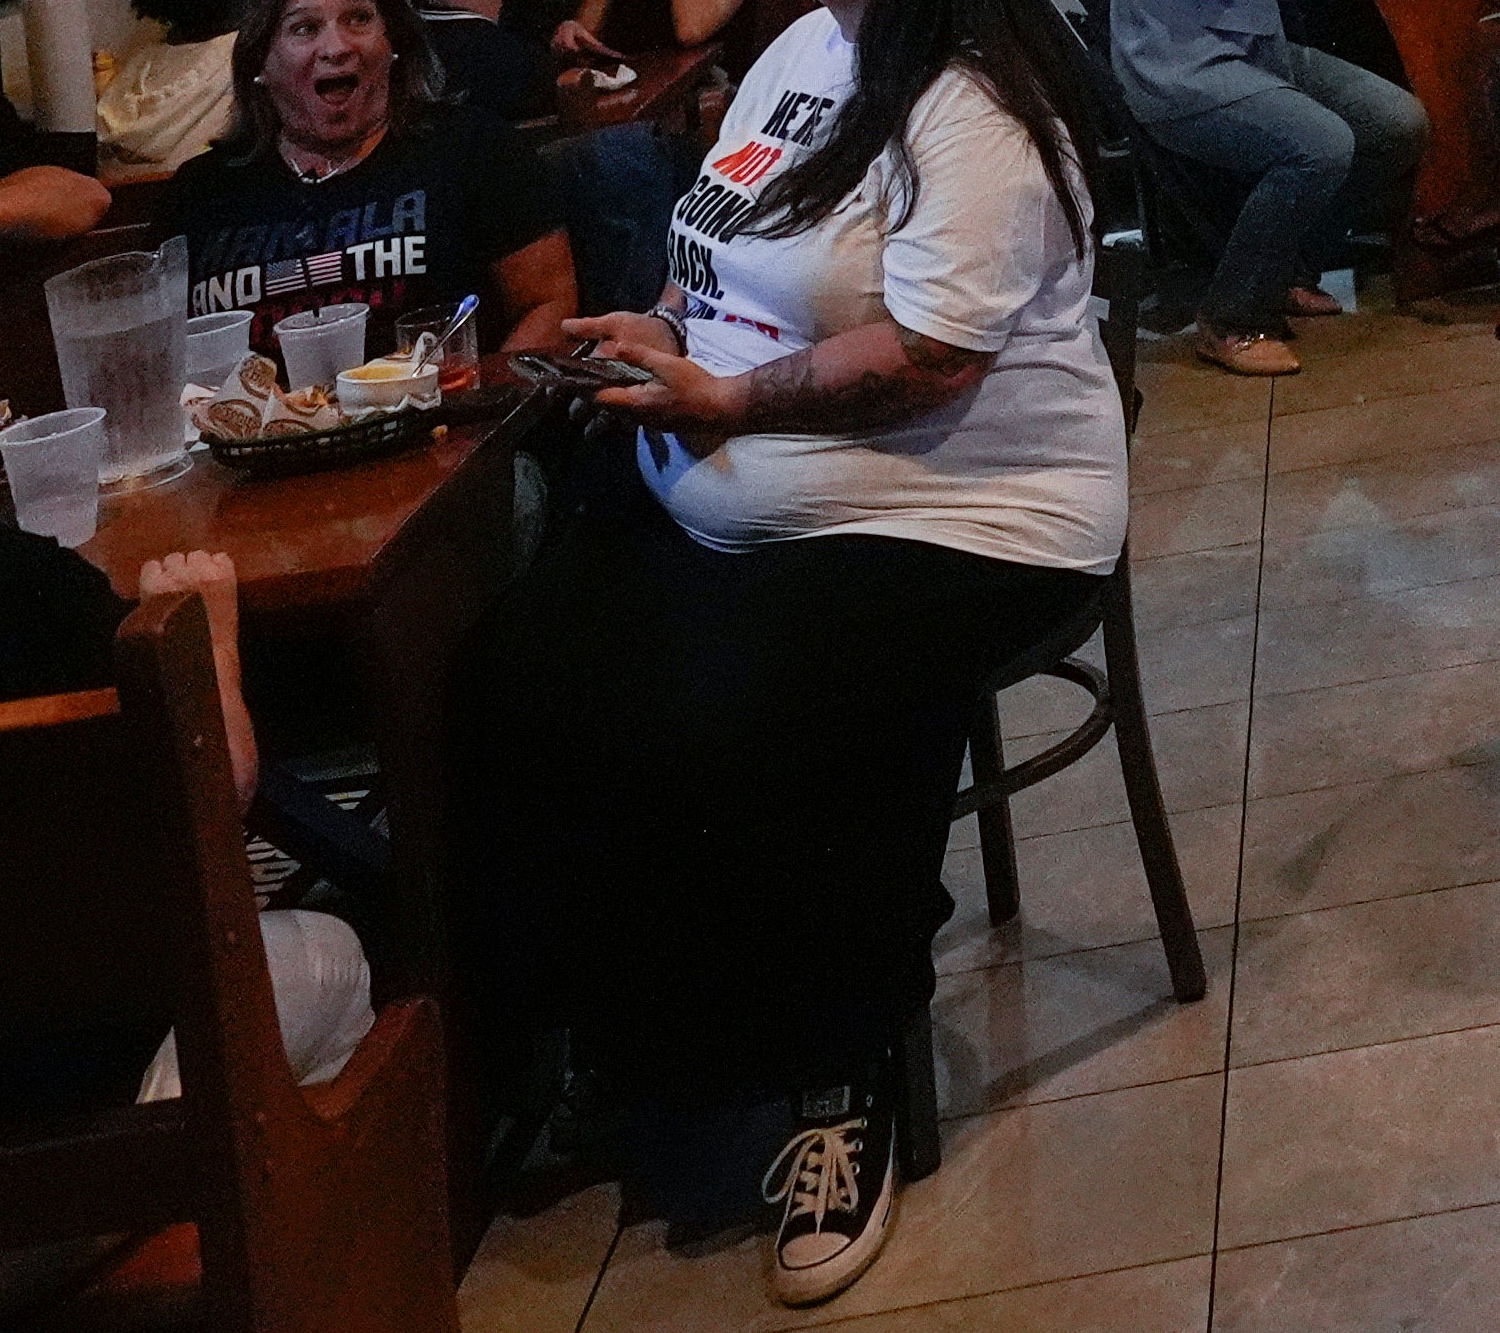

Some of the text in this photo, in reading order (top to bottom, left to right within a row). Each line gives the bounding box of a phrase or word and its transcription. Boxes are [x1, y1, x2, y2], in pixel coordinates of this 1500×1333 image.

[711, 140, 784, 188] NOT
[191, 264, 262, 318] AND
[345, 234, 428, 282] THE
